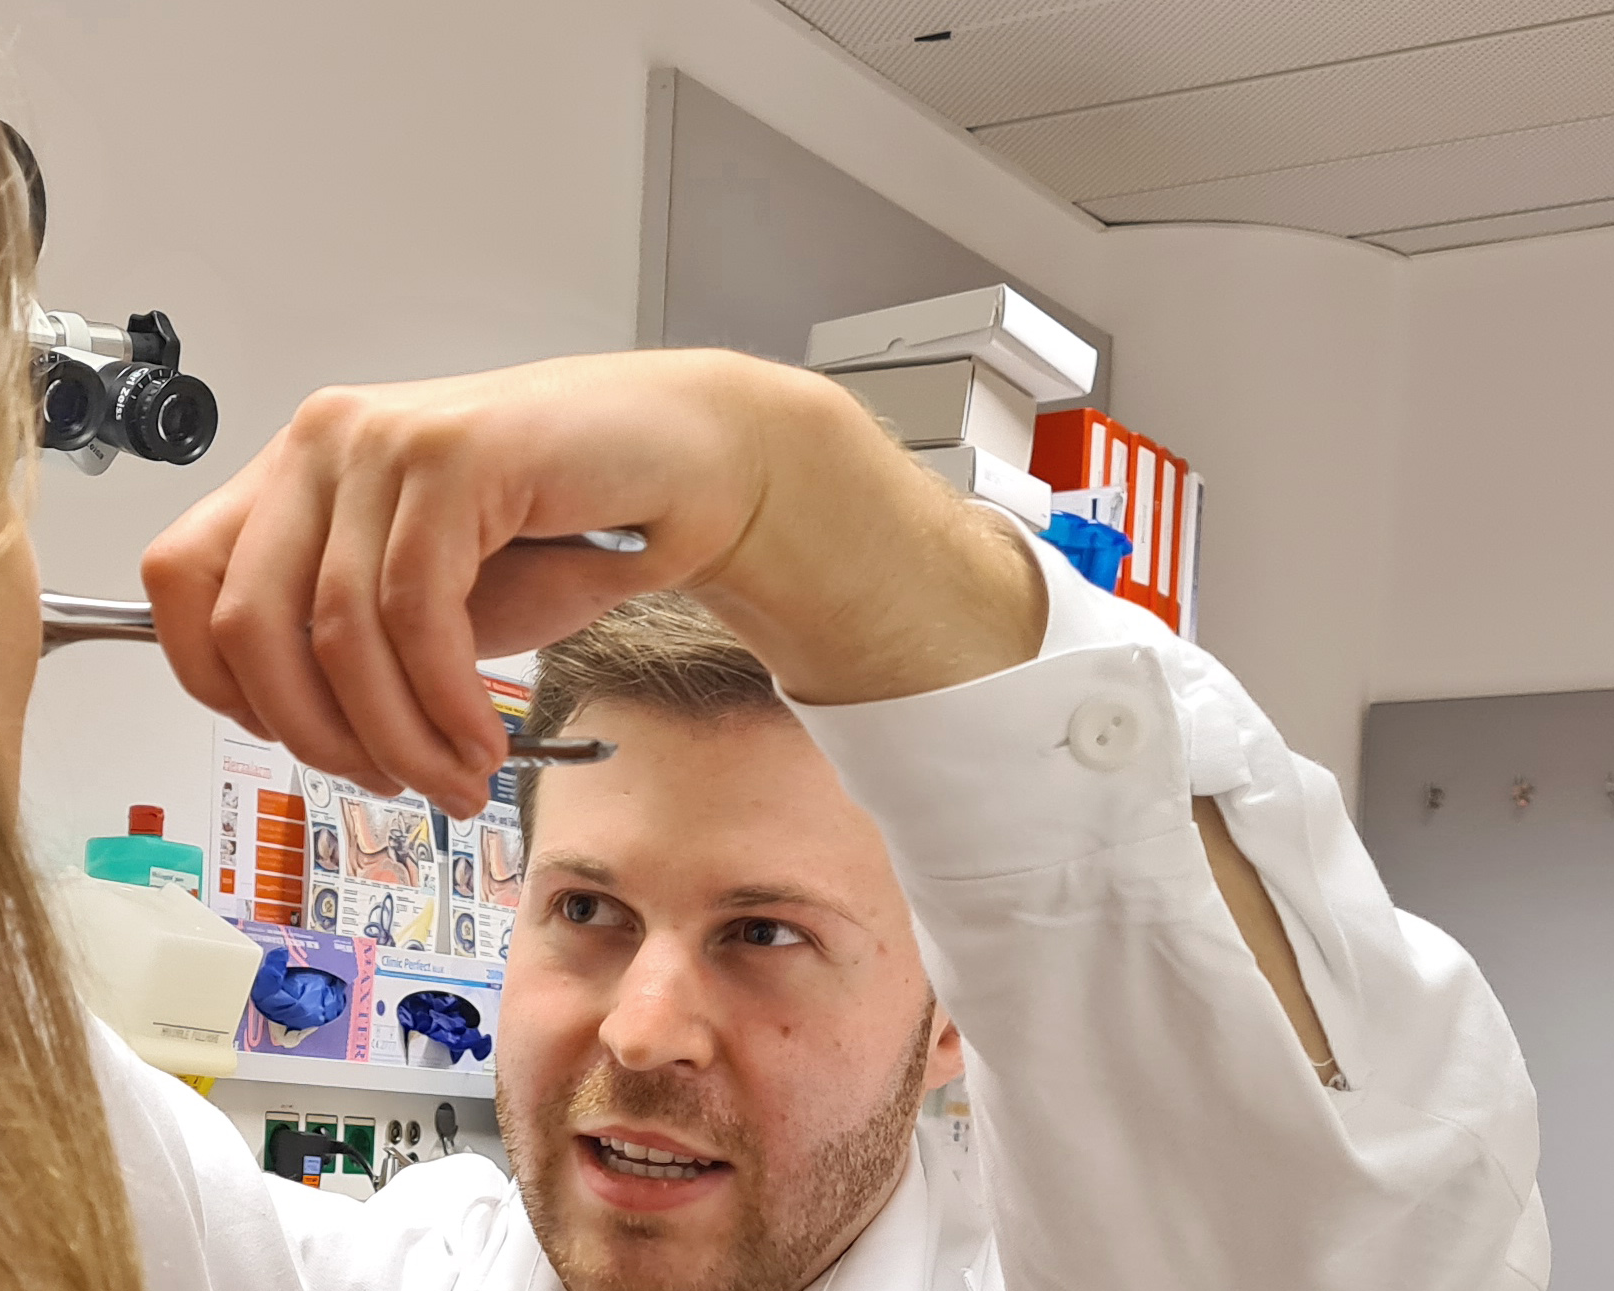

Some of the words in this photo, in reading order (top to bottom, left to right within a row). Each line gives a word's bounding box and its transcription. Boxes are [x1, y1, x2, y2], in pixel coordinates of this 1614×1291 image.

[126, 368, 149, 386] Carl
[115, 387, 130, 420] Zeiss
[381, 955, 403, 968] Clinic
[404, 958, 431, 972] Perfect
